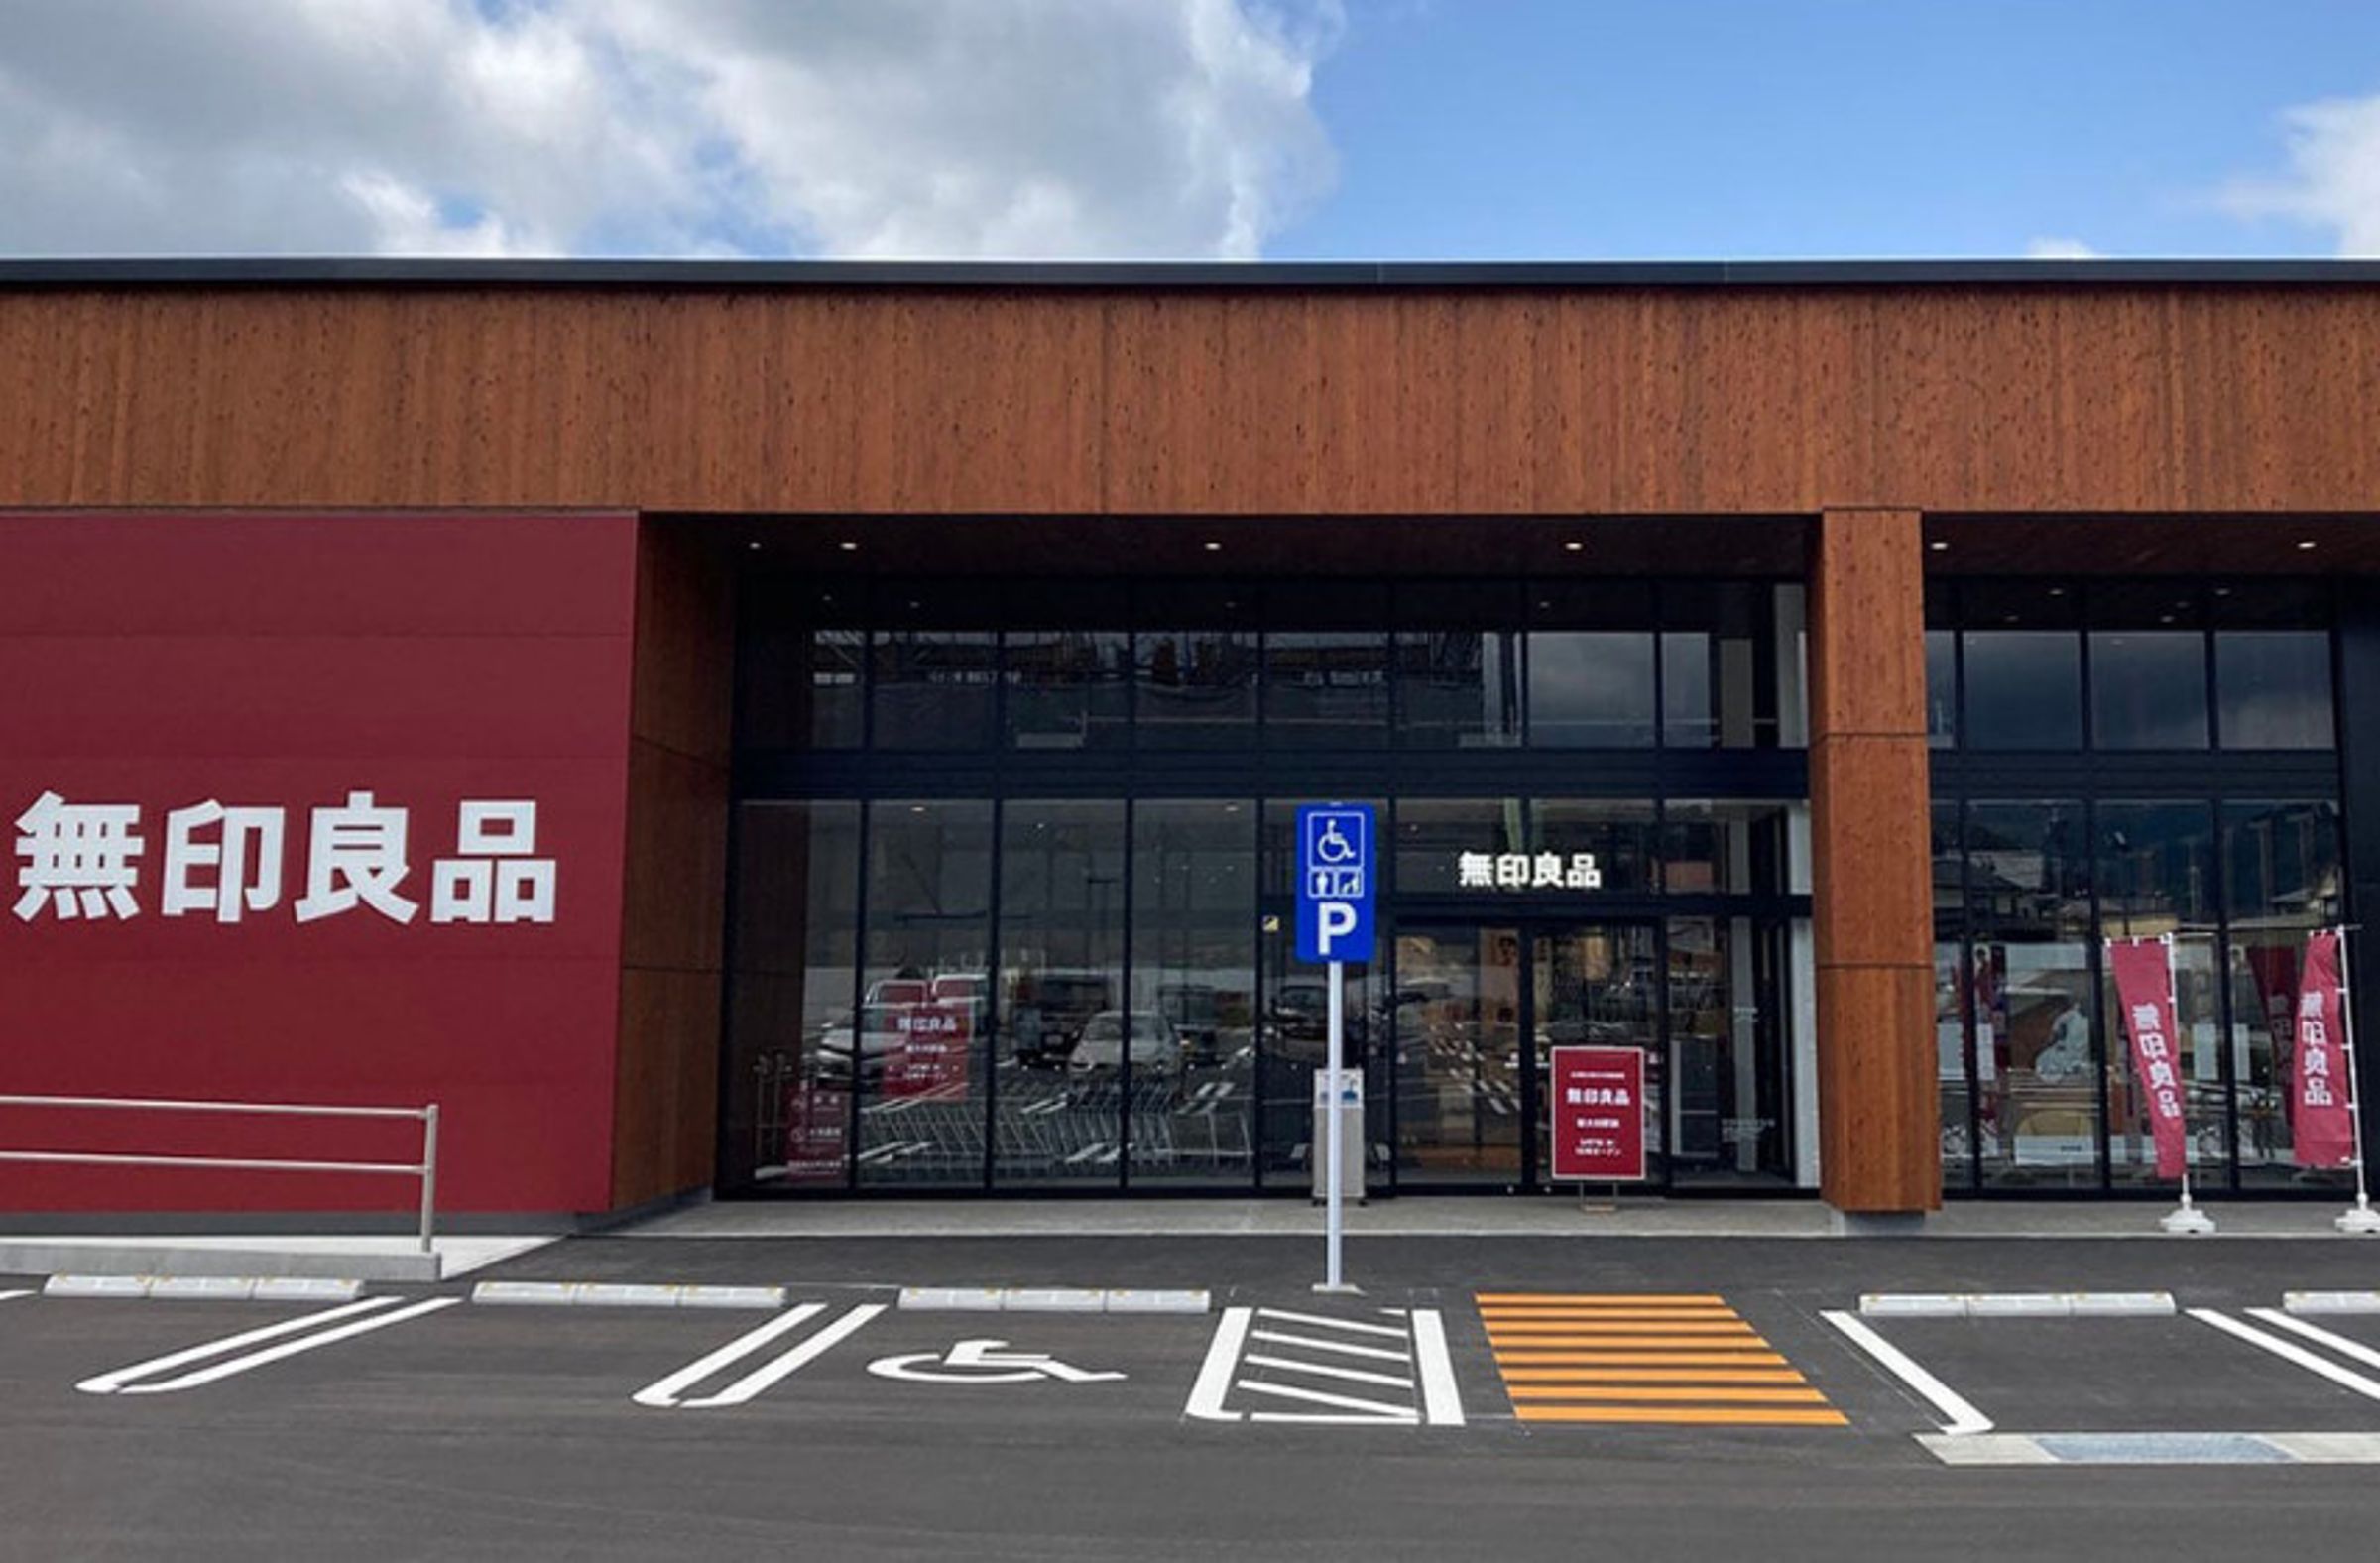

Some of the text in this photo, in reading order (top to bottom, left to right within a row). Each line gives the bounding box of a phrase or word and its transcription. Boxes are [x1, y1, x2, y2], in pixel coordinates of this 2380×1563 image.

[12, 789, 557, 924] 無印良品
[1458, 851, 1601, 888] 無印良品
[1318, 902, 1357, 955] P
[1566, 1087, 1630, 1106] 無印良品
